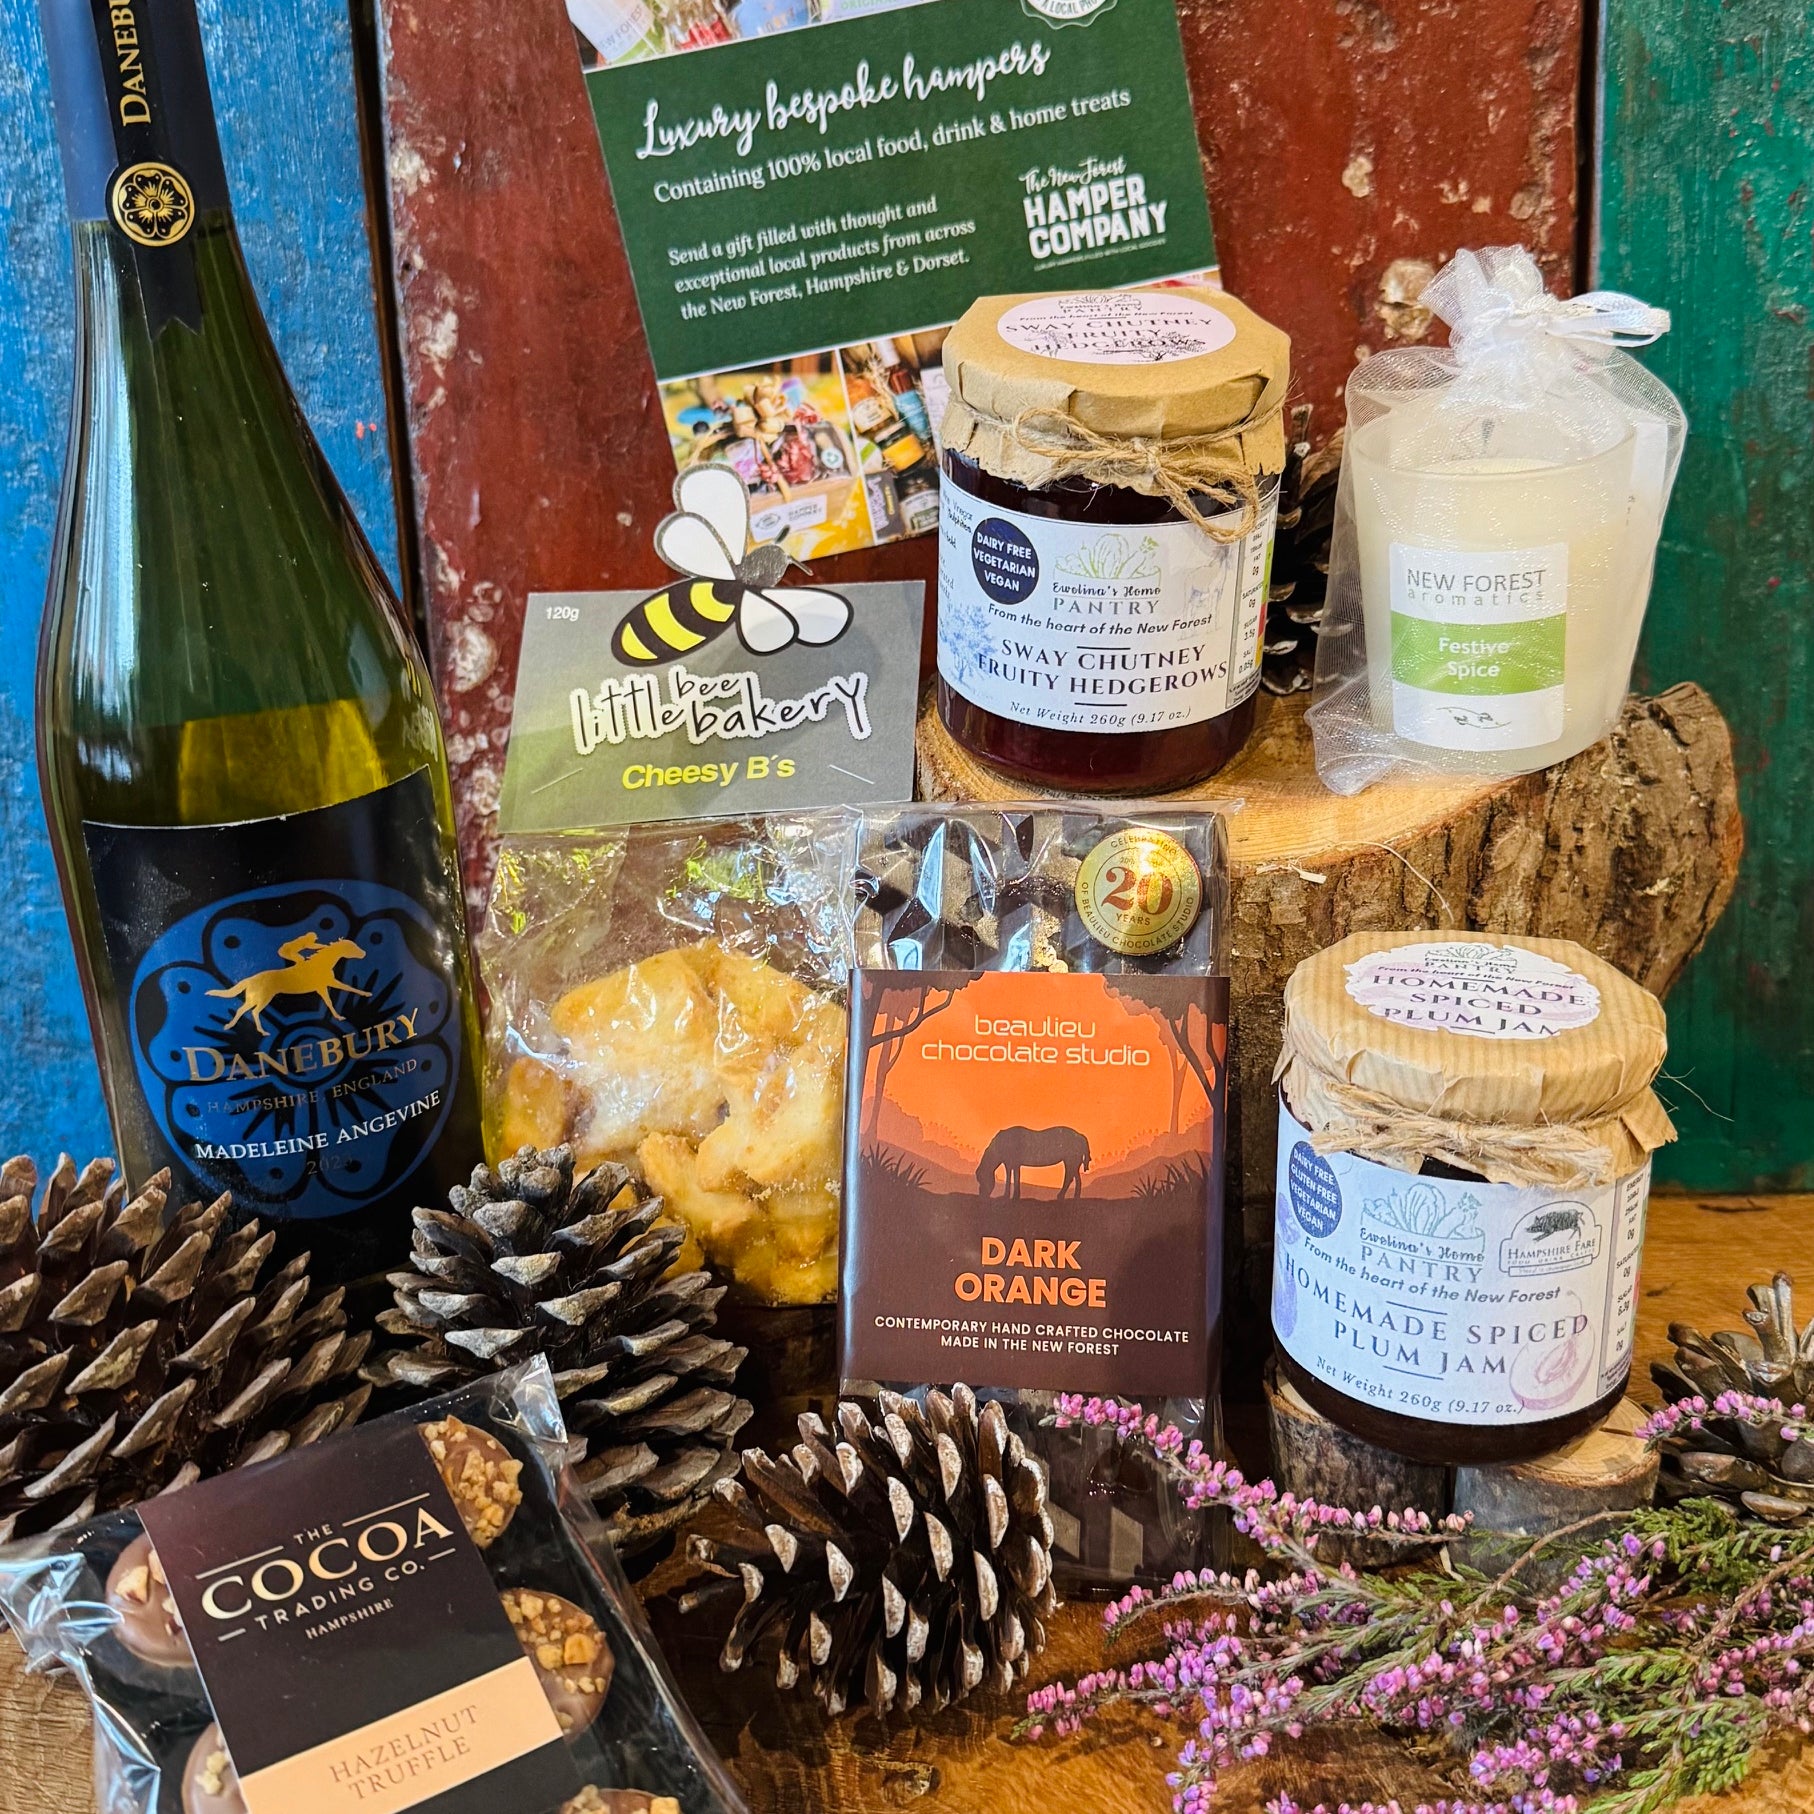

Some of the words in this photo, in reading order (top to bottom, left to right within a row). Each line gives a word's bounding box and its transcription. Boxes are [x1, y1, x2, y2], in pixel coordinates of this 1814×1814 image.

[1049, 2, 1079, 15] LOCAL
[110, 0, 151, 127] DANEB
[636, 98, 762, 159] Luxury
[766, 59, 898, 134] bespoke
[903, 40, 1050, 101] hampers
[653, 165, 766, 203] Containing
[768, 152, 822, 181] 100%
[823, 138, 873, 170] local
[876, 127, 929, 160] food,
[932, 115, 987, 148] drink
[988, 114, 1007, 135] &
[1010, 103, 1068, 131] home
[1070, 89, 1132, 118] treats
[1019, 165, 1049, 194] The
[1048, 165, 1080, 187] New
[1079, 154, 1127, 184] Forest
[1023, 174, 1147, 228] HAMPER
[667, 240, 711, 266] Send
[711, 243, 724, 258] a
[726, 233, 754, 259] gift
[756, 222, 798, 253] filled
[801, 215, 838, 240] with
[840, 203, 903, 229] thought
[906, 193, 938, 218] and
[1028, 200, 1168, 259] COMPANY
[674, 258, 766, 293] exceptional
[768, 250, 807, 275] local
[810, 239, 880, 270] products
[882, 230, 921, 257] from
[925, 219, 976, 242] across
[680, 300, 707, 320] the
[710, 294, 746, 314] New
[750, 282, 803, 307] Forest,
[805, 265, 893, 295] Hampshire
[896, 260, 910, 276] &
[913, 248, 970, 273] Dorset.
[1005, 321, 1075, 332] SWAY
[1086, 318, 1213, 328] CHUTNEY
[1067, 329, 1162, 340] FRUITY
[1033, 339, 1207, 351] HEDGEROWS
[973, 547, 1036, 578] VEGETARIAN
[977, 532, 1004, 551] DAIRY
[1007, 543, 1032, 560] FREE
[984, 570, 1020, 592] VEGAN
[1407, 568, 1456, 591] NEW
[1463, 569, 1547, 592] FOREST
[1408, 588, 1545, 606] aromatics
[545, 605, 580, 622] 120g
[988, 603, 1017, 622] From
[1021, 613, 1042, 628] the
[1046, 617, 1086, 633] heart
[1090, 622, 1107, 634] of
[1109, 623, 1132, 634] the
[1137, 623, 1169, 634] New
[1172, 614, 1213, 631] Forest
[1053, 597, 1160, 615] PANTRY
[1002, 639, 1069, 667] SWAY
[1078, 644, 1206, 671] CHUTNEY
[1438, 637, 1511, 655] Festive
[675, 670, 740, 700] bee
[979, 653, 1059, 690] FRUITY
[1070, 661, 1228, 695] HEDGEROWS
[1448, 661, 1501, 680] Spice
[576, 679, 685, 749] little
[691, 672, 865, 740] bakery
[1010, 701, 1030, 716] Net
[1037, 704, 1084, 725] Weight
[1090, 714, 1126, 728] 260g
[1131, 711, 1165, 726] (9.17
[1168, 705, 1192, 720] oz.)
[622, 760, 739, 790] Cheesy
[1081, 882, 1089, 894] OF
[1101, 867, 1174, 915] 20
[1082, 898, 1111, 939] BEAULIEU
[1116, 912, 1151, 926] YEARS
[1172, 896, 1194, 932] STUDIO
[1112, 930, 1175, 949] CHOCOLATE
[1373, 975, 1588, 1006] HOMEMADE
[1409, 993, 1543, 1016] SPICED
[975, 1014, 1096, 1039] beaulieu
[1384, 1008, 1483, 1026] PLUM
[182, 1007, 420, 1083] DANEBURY
[921, 1040, 1059, 1064] chocolate
[1065, 1043, 1151, 1066] studio
[332, 1058, 418, 1099] ENGLAND
[194, 1132, 329, 1160] MADELEINE
[336, 1090, 441, 1145] ANGEVINE
[1290, 1163, 1316, 1192] GLUTEN
[1317, 1184, 1337, 1205] FREE
[1293, 1148, 1313, 1172] DAIRY
[1314, 1166, 1335, 1186] FREE
[1290, 1179, 1336, 1221] VEGETARIAN
[1297, 1201, 1324, 1232] VEGAN
[981, 1236, 1082, 1270] DARK
[1361, 1245, 1483, 1284] PANTRY
[1507, 1244, 1571, 1260] HAMPSHIRE
[1575, 1238, 1596, 1252] FARE
[1304, 1236, 1332, 1264] From
[1336, 1257, 1357, 1275] the
[1360, 1266, 1405, 1291] heart
[1408, 1282, 1429, 1296] of
[1432, 1285, 1460, 1301] the
[1465, 1289, 1505, 1303] New
[1508, 1286, 1561, 1303] Forest
[954, 1272, 1107, 1308] ORANGE
[1285, 1252, 1447, 1341] HOMEMADE
[1466, 1314, 1588, 1345] SPICED
[874, 1316, 987, 1334] CONTEMPORARY
[992, 1322, 1031, 1336] HAND
[1035, 1324, 1099, 1339] CRAFTED
[1102, 1327, 1190, 1343] CHOCOLATE
[941, 1334, 980, 1349] MADE
[983, 1337, 998, 1350] IN
[1002, 1338, 1027, 1351] THE
[1032, 1340, 1064, 1353] NEW
[1068, 1341, 1119, 1356] FOREST
[1334, 1319, 1420, 1366] PLUM
[1439, 1351, 1506, 1374] JAM
[1316, 1355, 1337, 1377] Net
[1342, 1370, 1393, 1399] Weight
[1400, 1390, 1442, 1413] 260g
[1447, 1399, 1490, 1414] (9.17
[1495, 1398, 1525, 1415] oz.)
[293, 1523, 334, 1546] THE
[201, 1507, 454, 1620] COCOA
[254, 1577, 375, 1632] TRADING
[384, 1560, 425, 1583] CO.
[305, 1598, 394, 1640] HAMPSHIRE
[329, 1705, 478, 1783] HAZELNUT
[348, 1736, 471, 1800] TRUFFLE
